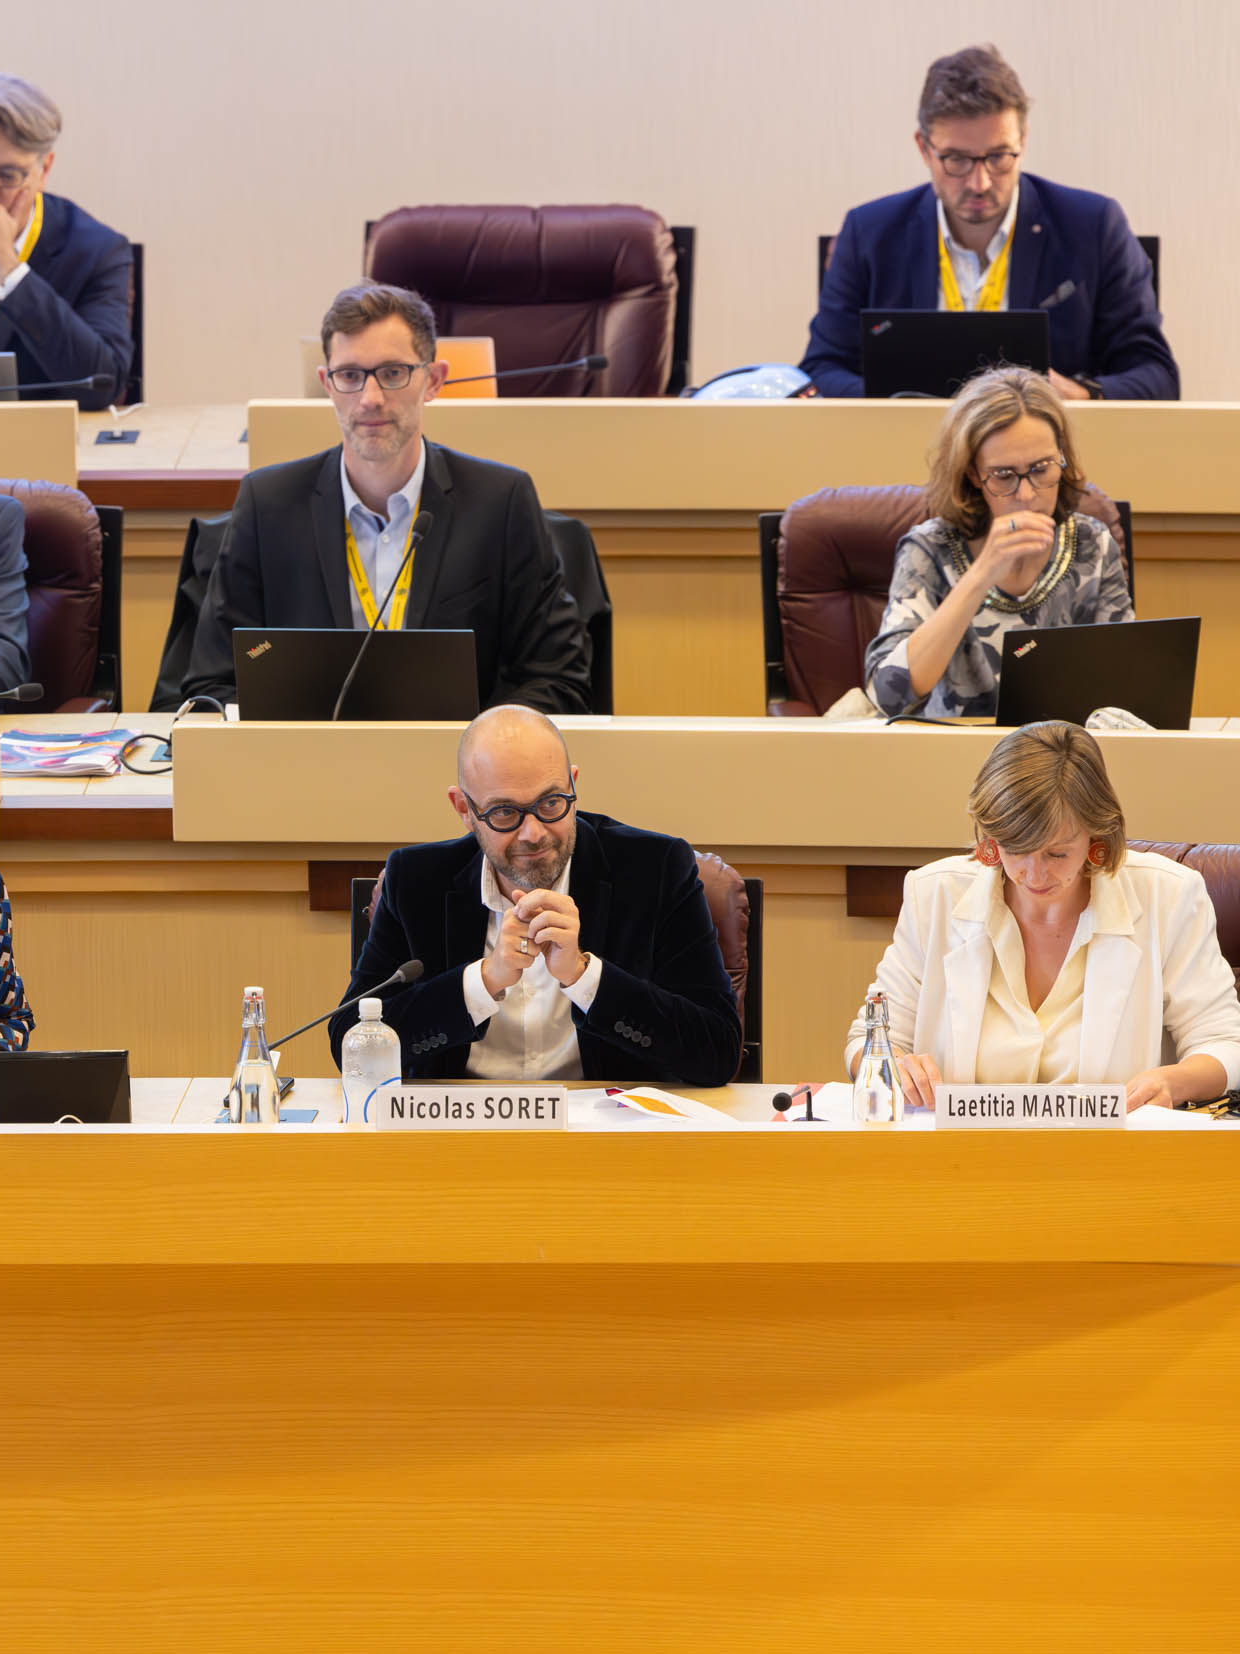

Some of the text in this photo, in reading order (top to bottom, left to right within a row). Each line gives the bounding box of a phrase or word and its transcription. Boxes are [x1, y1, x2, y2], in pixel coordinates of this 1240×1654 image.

[390, 1096, 561, 1119] Nicolas SORET
[948, 1093, 1120, 1118] Laetitia MARTINEZ
